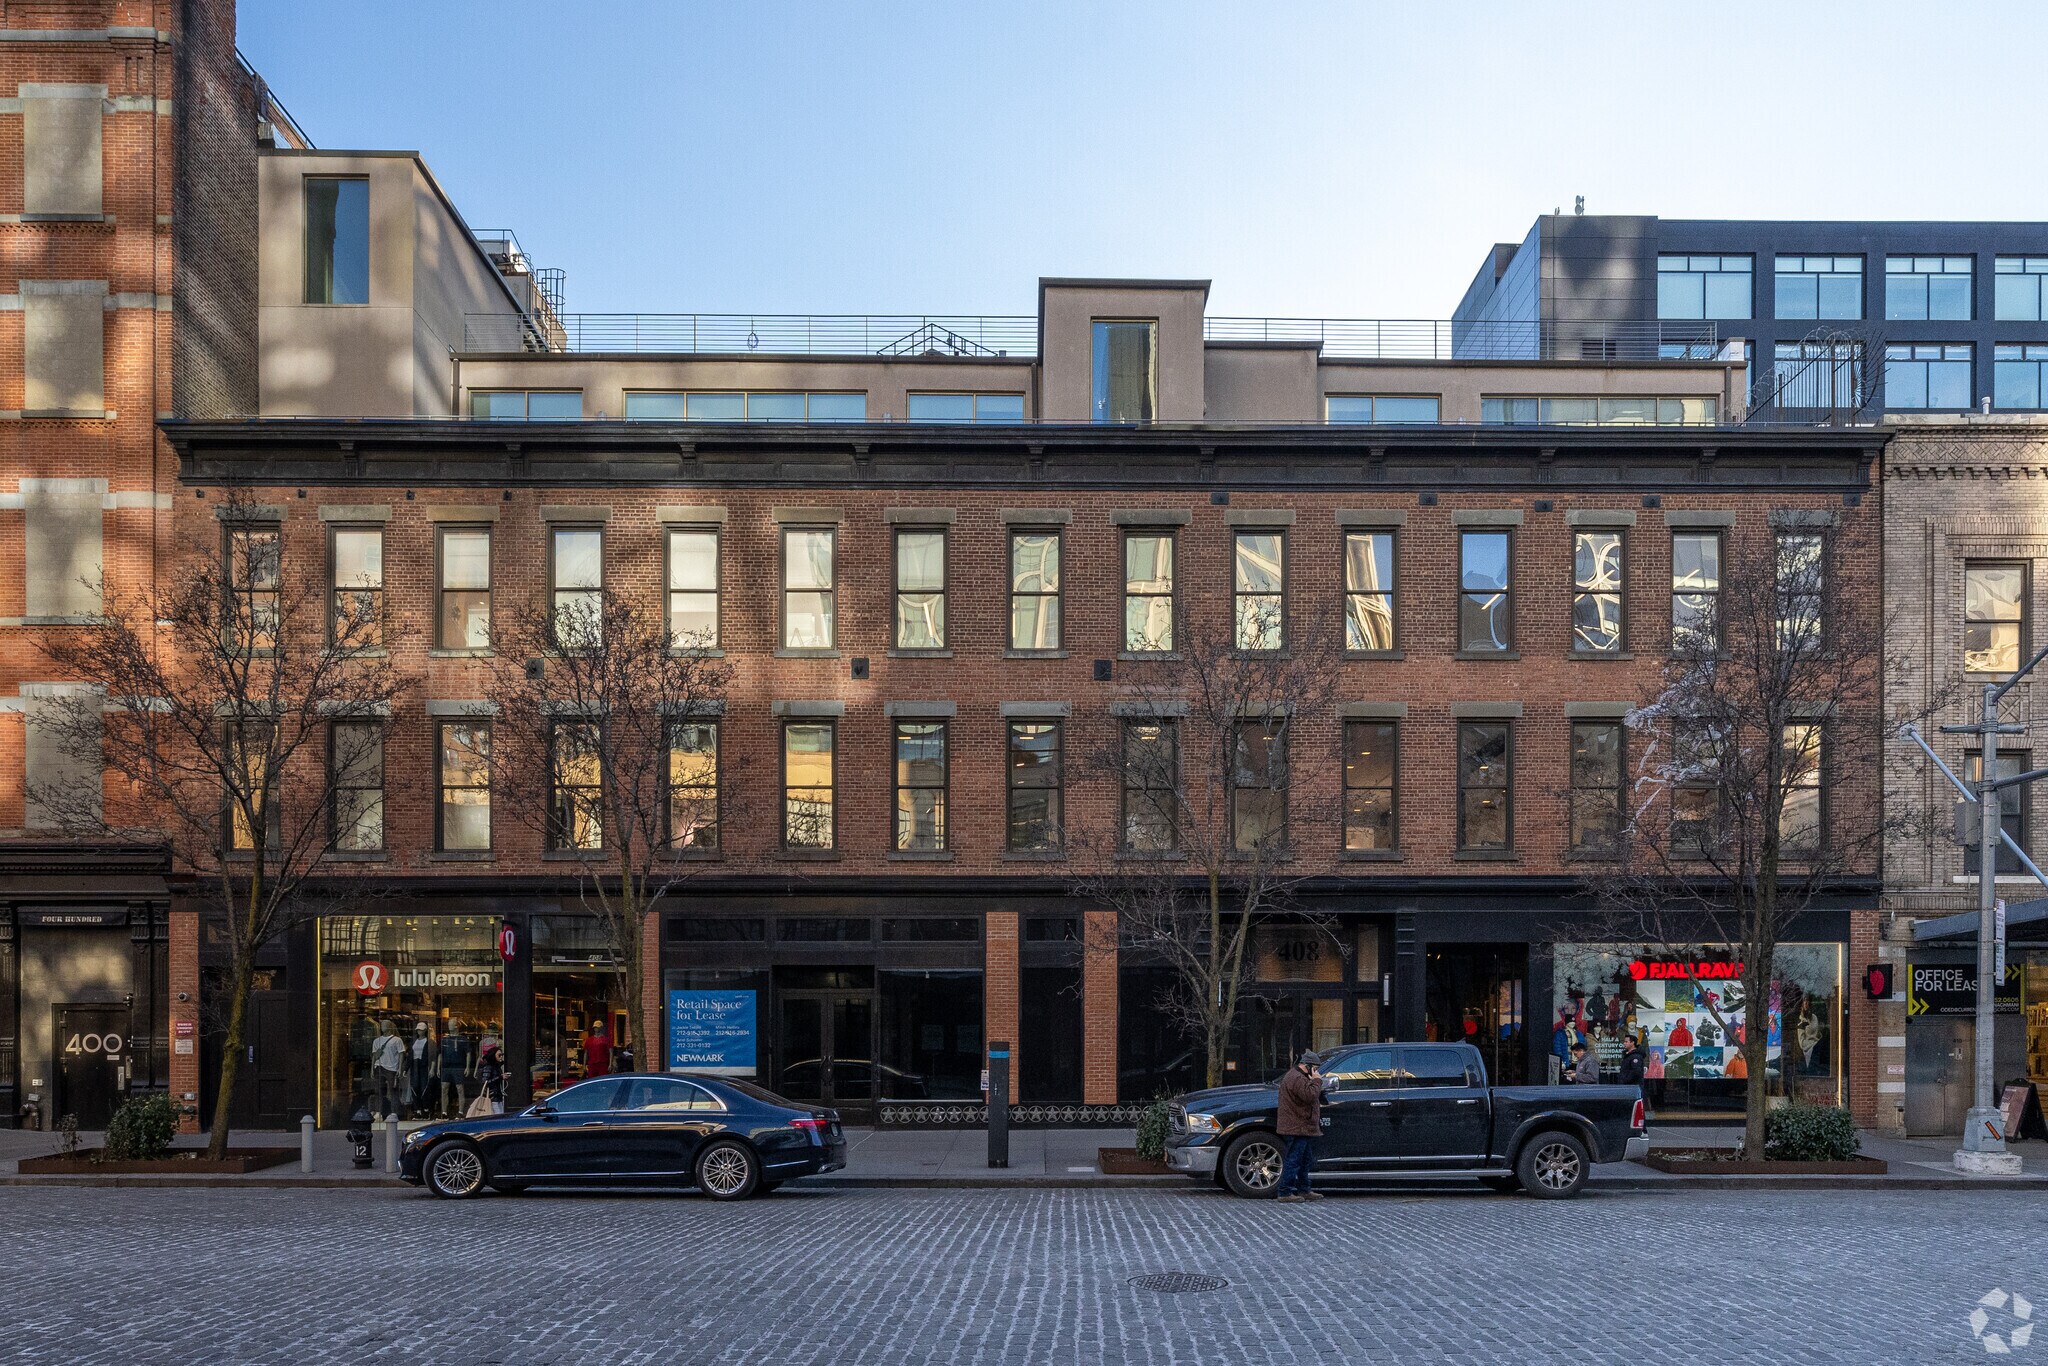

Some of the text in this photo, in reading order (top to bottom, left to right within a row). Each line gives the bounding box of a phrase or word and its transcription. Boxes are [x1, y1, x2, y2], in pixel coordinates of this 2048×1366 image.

[1278, 941, 1319, 961] 408
[1649, 961, 1745, 979] FJÄLLRÄV
[1914, 969, 1963, 981] OFFICE
[394, 969, 490, 987] lululemon
[1915, 980, 1978, 992] FOR LEAS
[677, 998, 742, 1012] Retail Space
[677, 1010, 726, 1020] for Lease
[65, 1033, 123, 1055] 400
[676, 1054, 724, 1062] NEWMARK
[356, 1145, 366, 1156] 12
